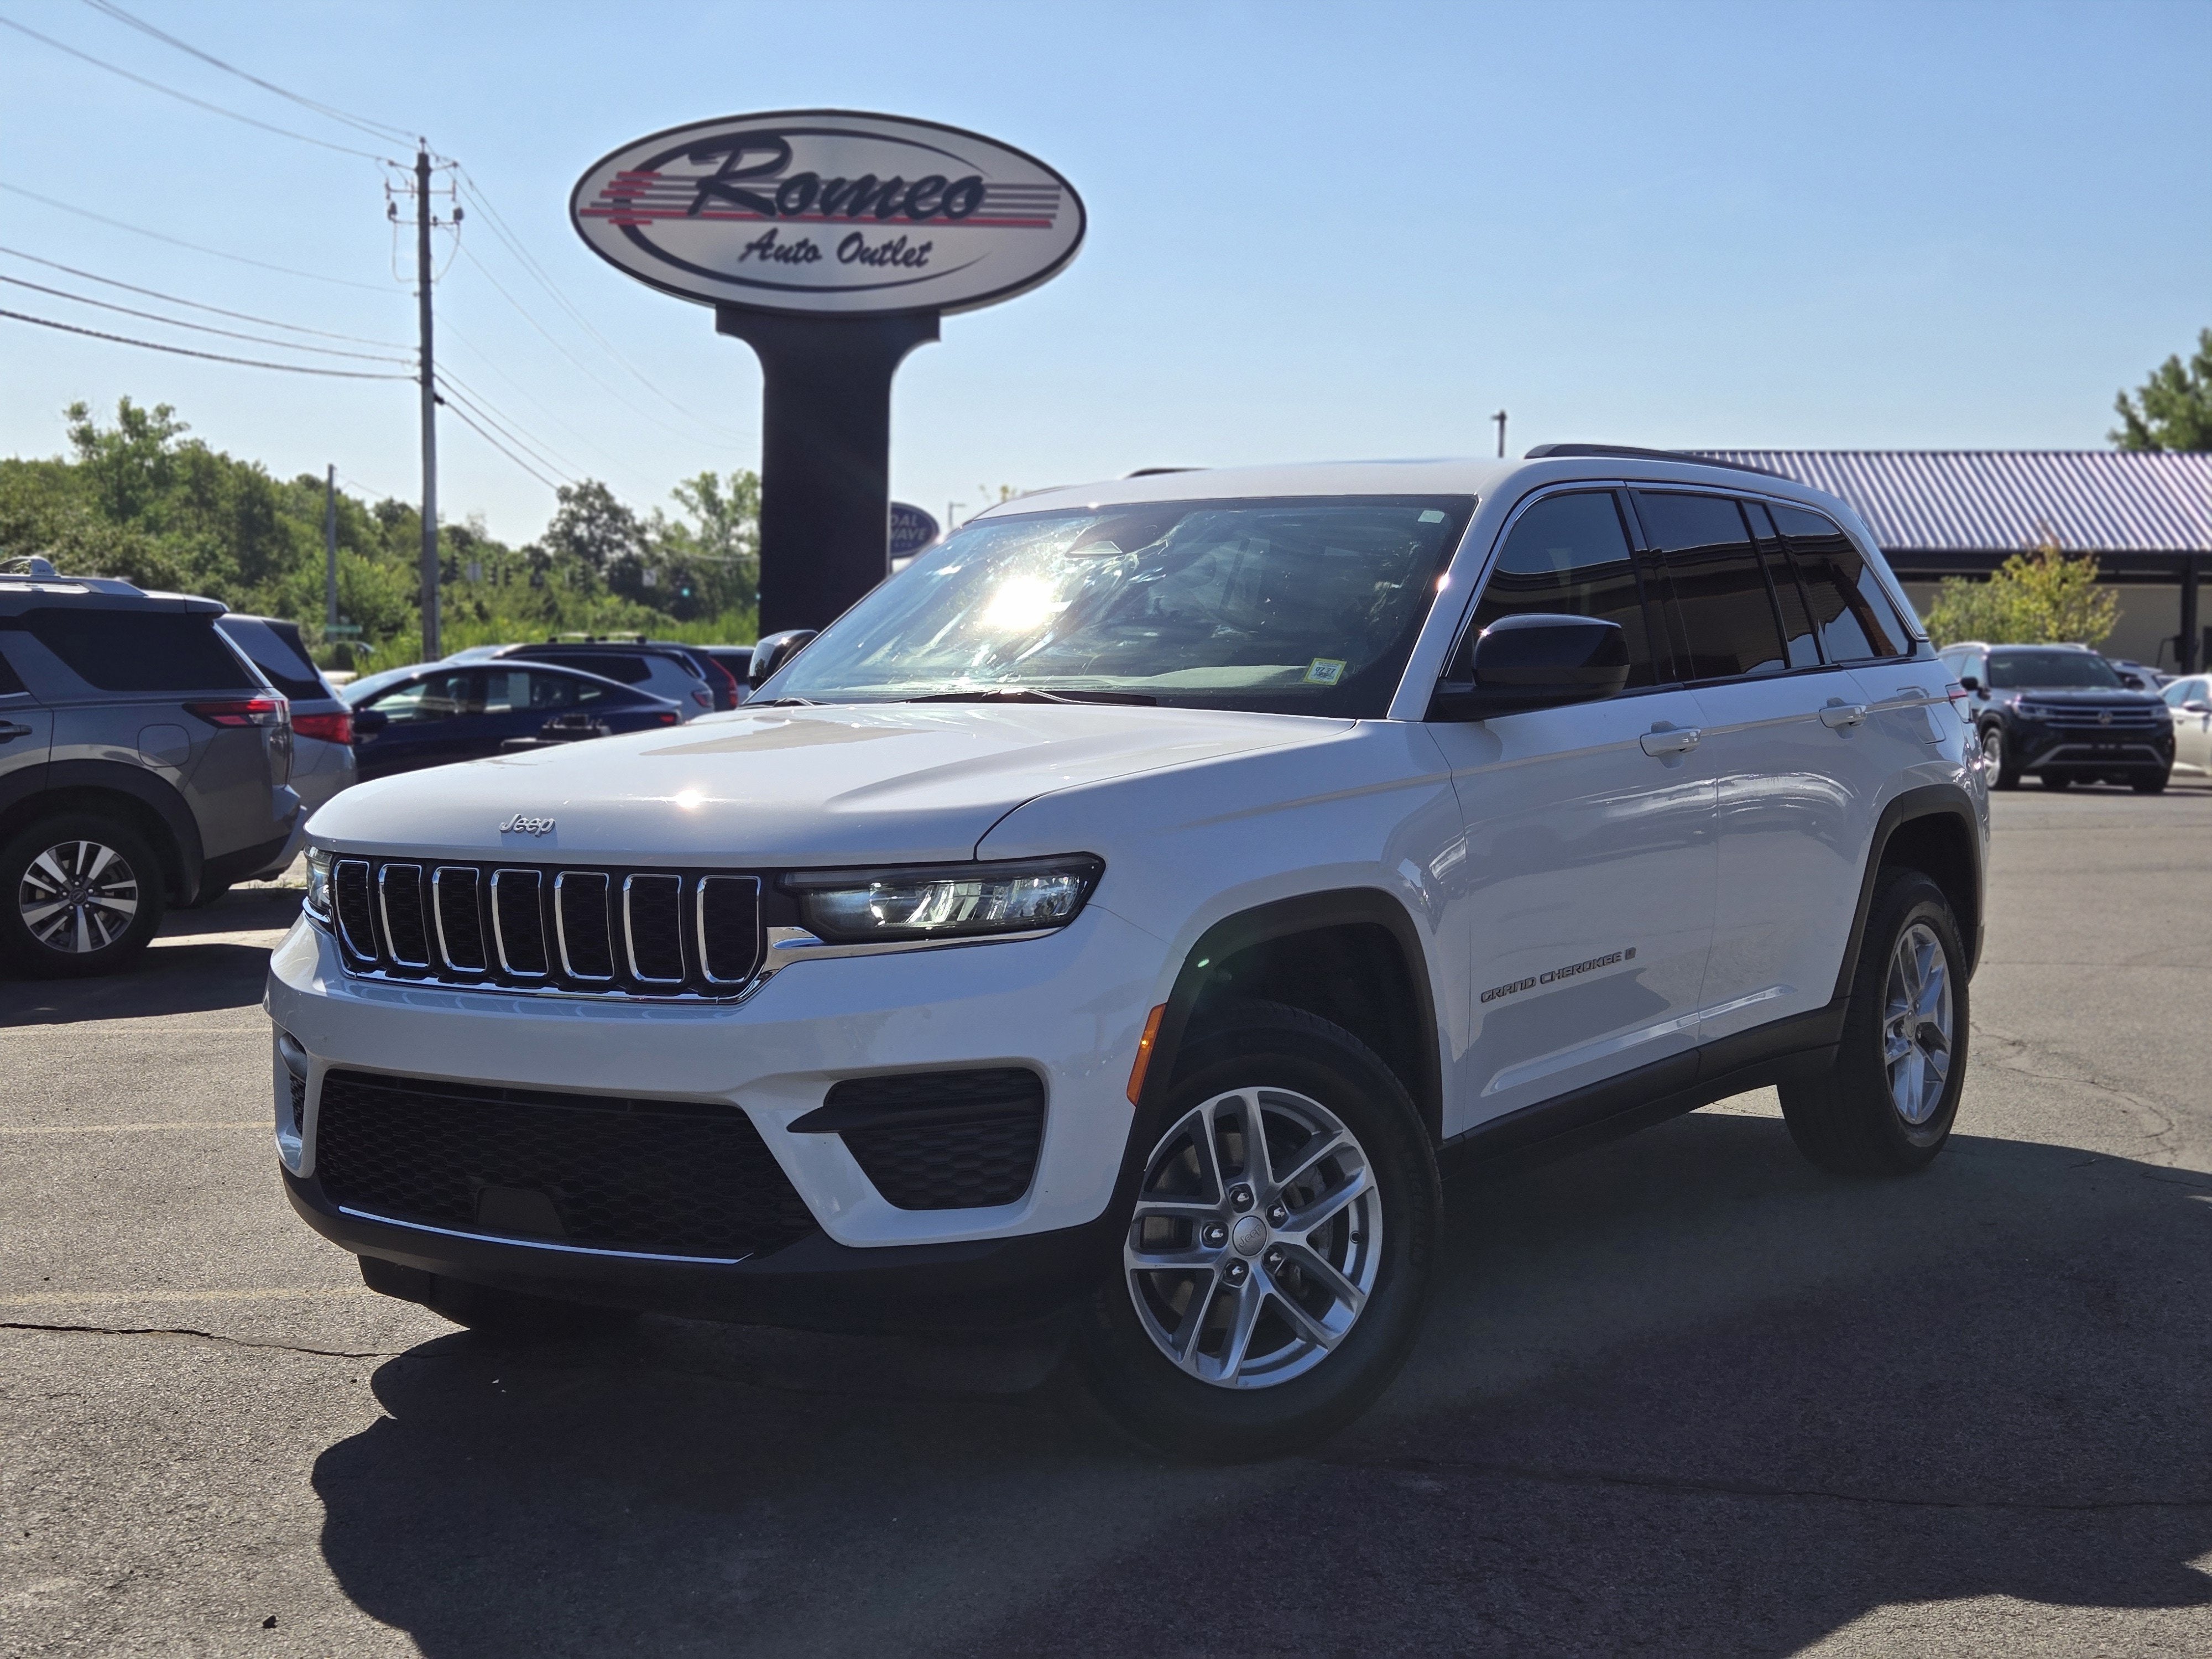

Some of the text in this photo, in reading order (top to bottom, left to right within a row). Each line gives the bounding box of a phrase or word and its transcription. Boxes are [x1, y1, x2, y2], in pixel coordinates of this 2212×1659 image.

[686, 133, 985, 220] Romeo
[738, 228, 932, 268] Auto Outlet
[499, 813, 556, 837] Jeep
[1480, 951, 1622, 1003] GRAND CHEROKEE
[1239, 1224, 1262, 1246] Jeep
